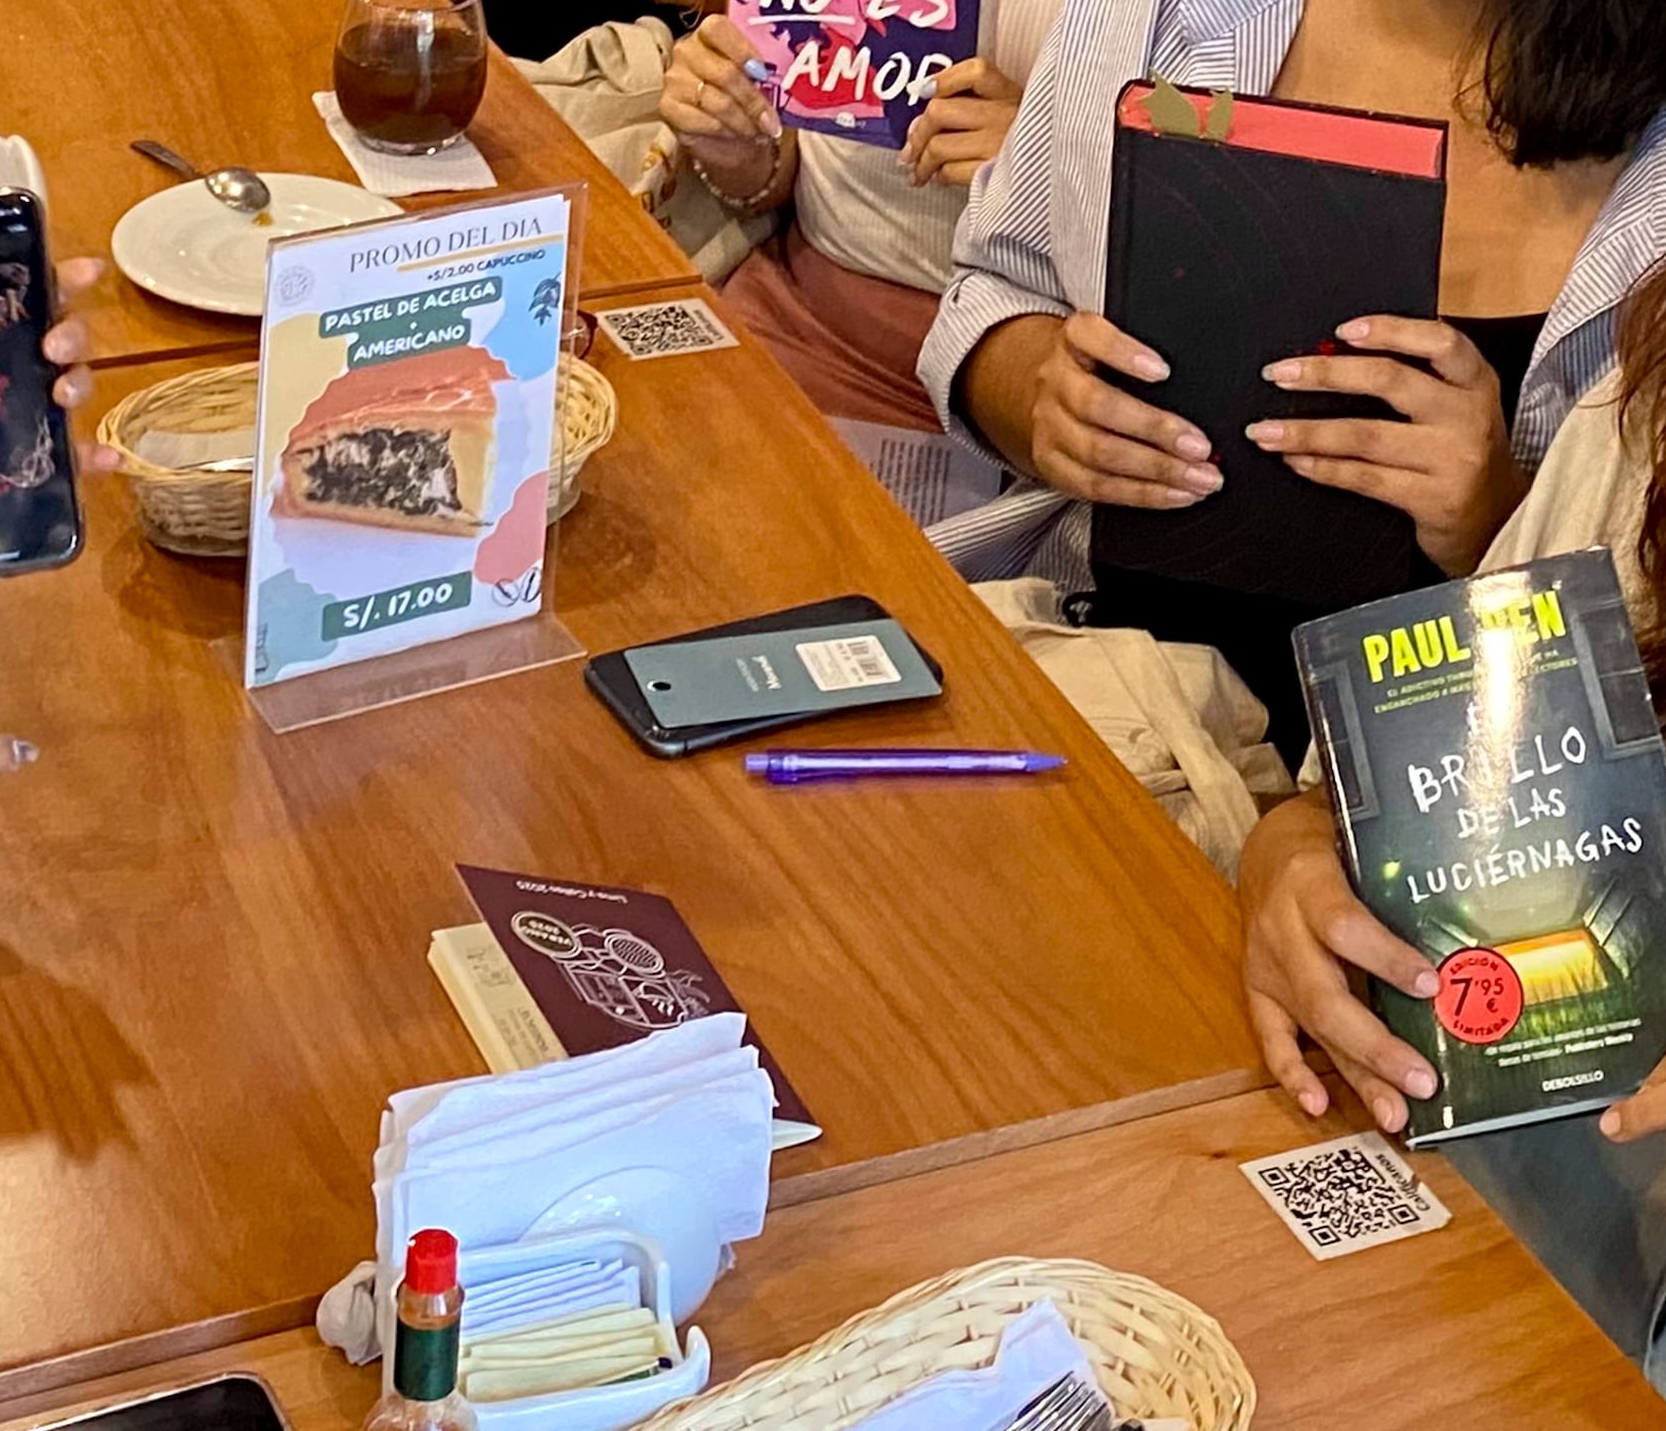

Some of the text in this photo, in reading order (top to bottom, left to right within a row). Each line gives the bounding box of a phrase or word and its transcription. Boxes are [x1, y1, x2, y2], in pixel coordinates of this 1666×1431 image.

[349, 236, 442, 273] PROMO
[447, 226, 496, 252] DEL
[476, 248, 546, 272] CAPUCCINO
[324, 280, 497, 333] PASTEL DE ACELGA
[352, 324, 466, 363] AMERICANO
[343, 582, 454, 630] S/. 17.00
[1362, 615, 1472, 684] PAUL
[1457, 787, 1566, 839] DE LAS
[1406, 817, 1643, 904] LUCIÉRNAGAS
[1452, 1017, 1510, 1036] LIMITADA
[1542, 1070, 1604, 1092] DEBOLSILLO
